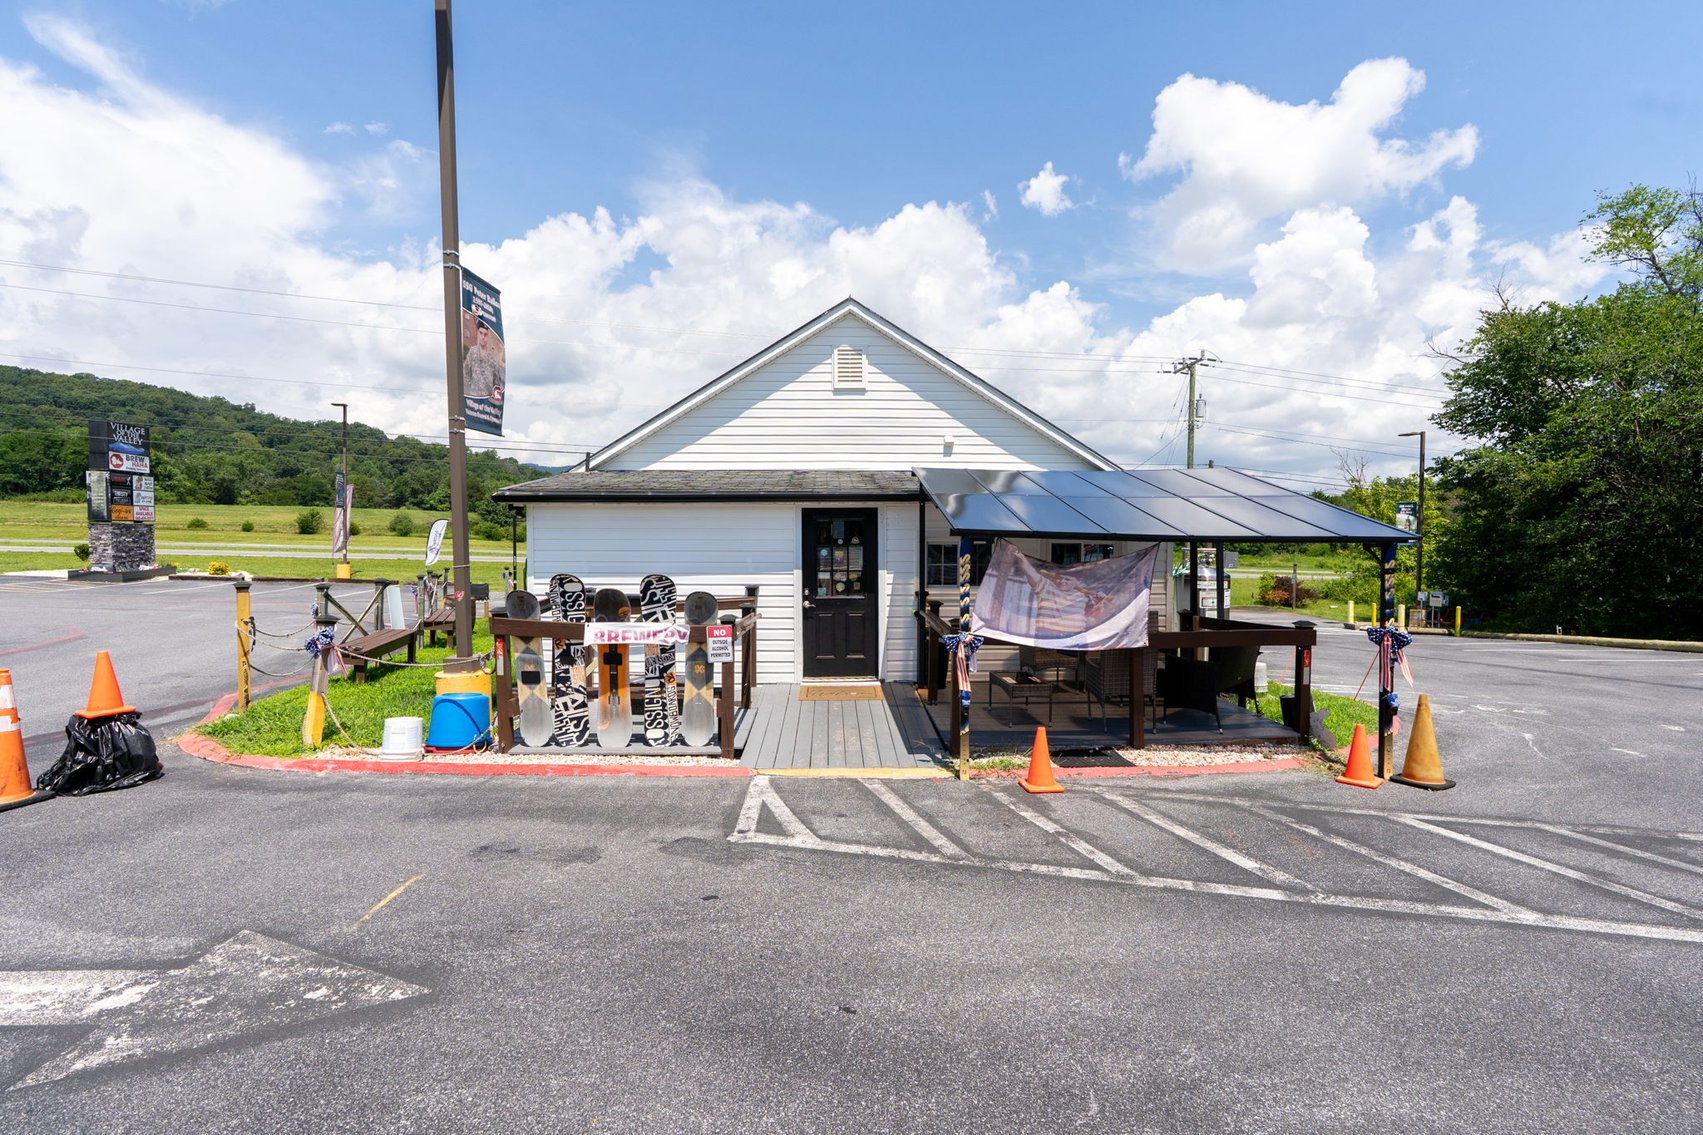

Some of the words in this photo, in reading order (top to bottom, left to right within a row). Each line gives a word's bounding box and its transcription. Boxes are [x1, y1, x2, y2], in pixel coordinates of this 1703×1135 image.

[110, 421, 146, 435] VILLAGE
[112, 434, 143, 445] VALLEY
[126, 455, 145, 463] BREW
